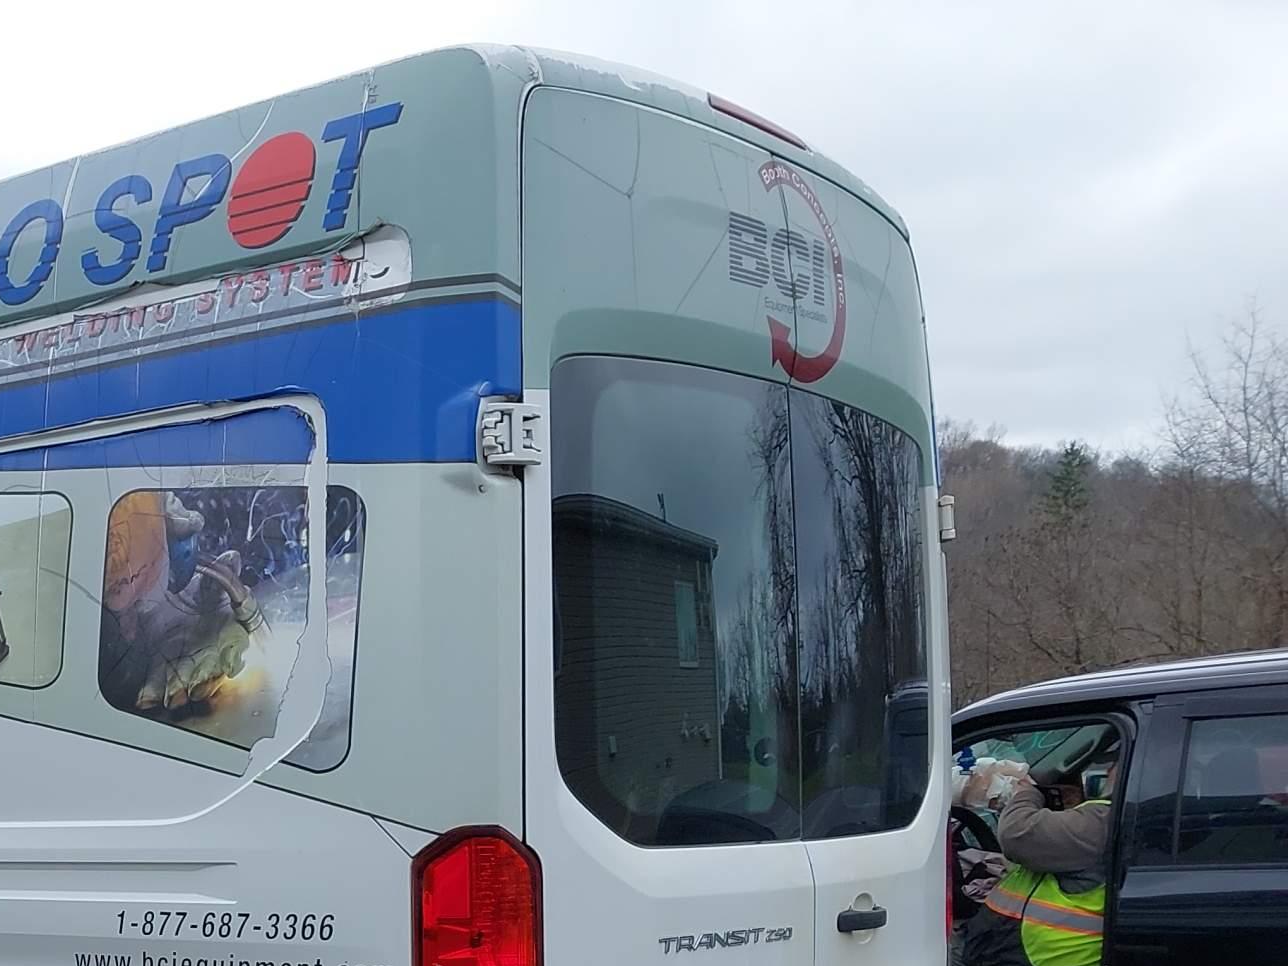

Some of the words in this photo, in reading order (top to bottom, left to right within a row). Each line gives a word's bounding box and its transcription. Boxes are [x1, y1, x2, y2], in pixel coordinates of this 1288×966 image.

[762, 165, 790, 185] Booth
[81, 102, 404, 286] SPOT
[729, 211, 824, 306] BCI
[116, 910, 335, 941] 1-877-687-3366
[658, 927, 765, 954] TRANSIT
